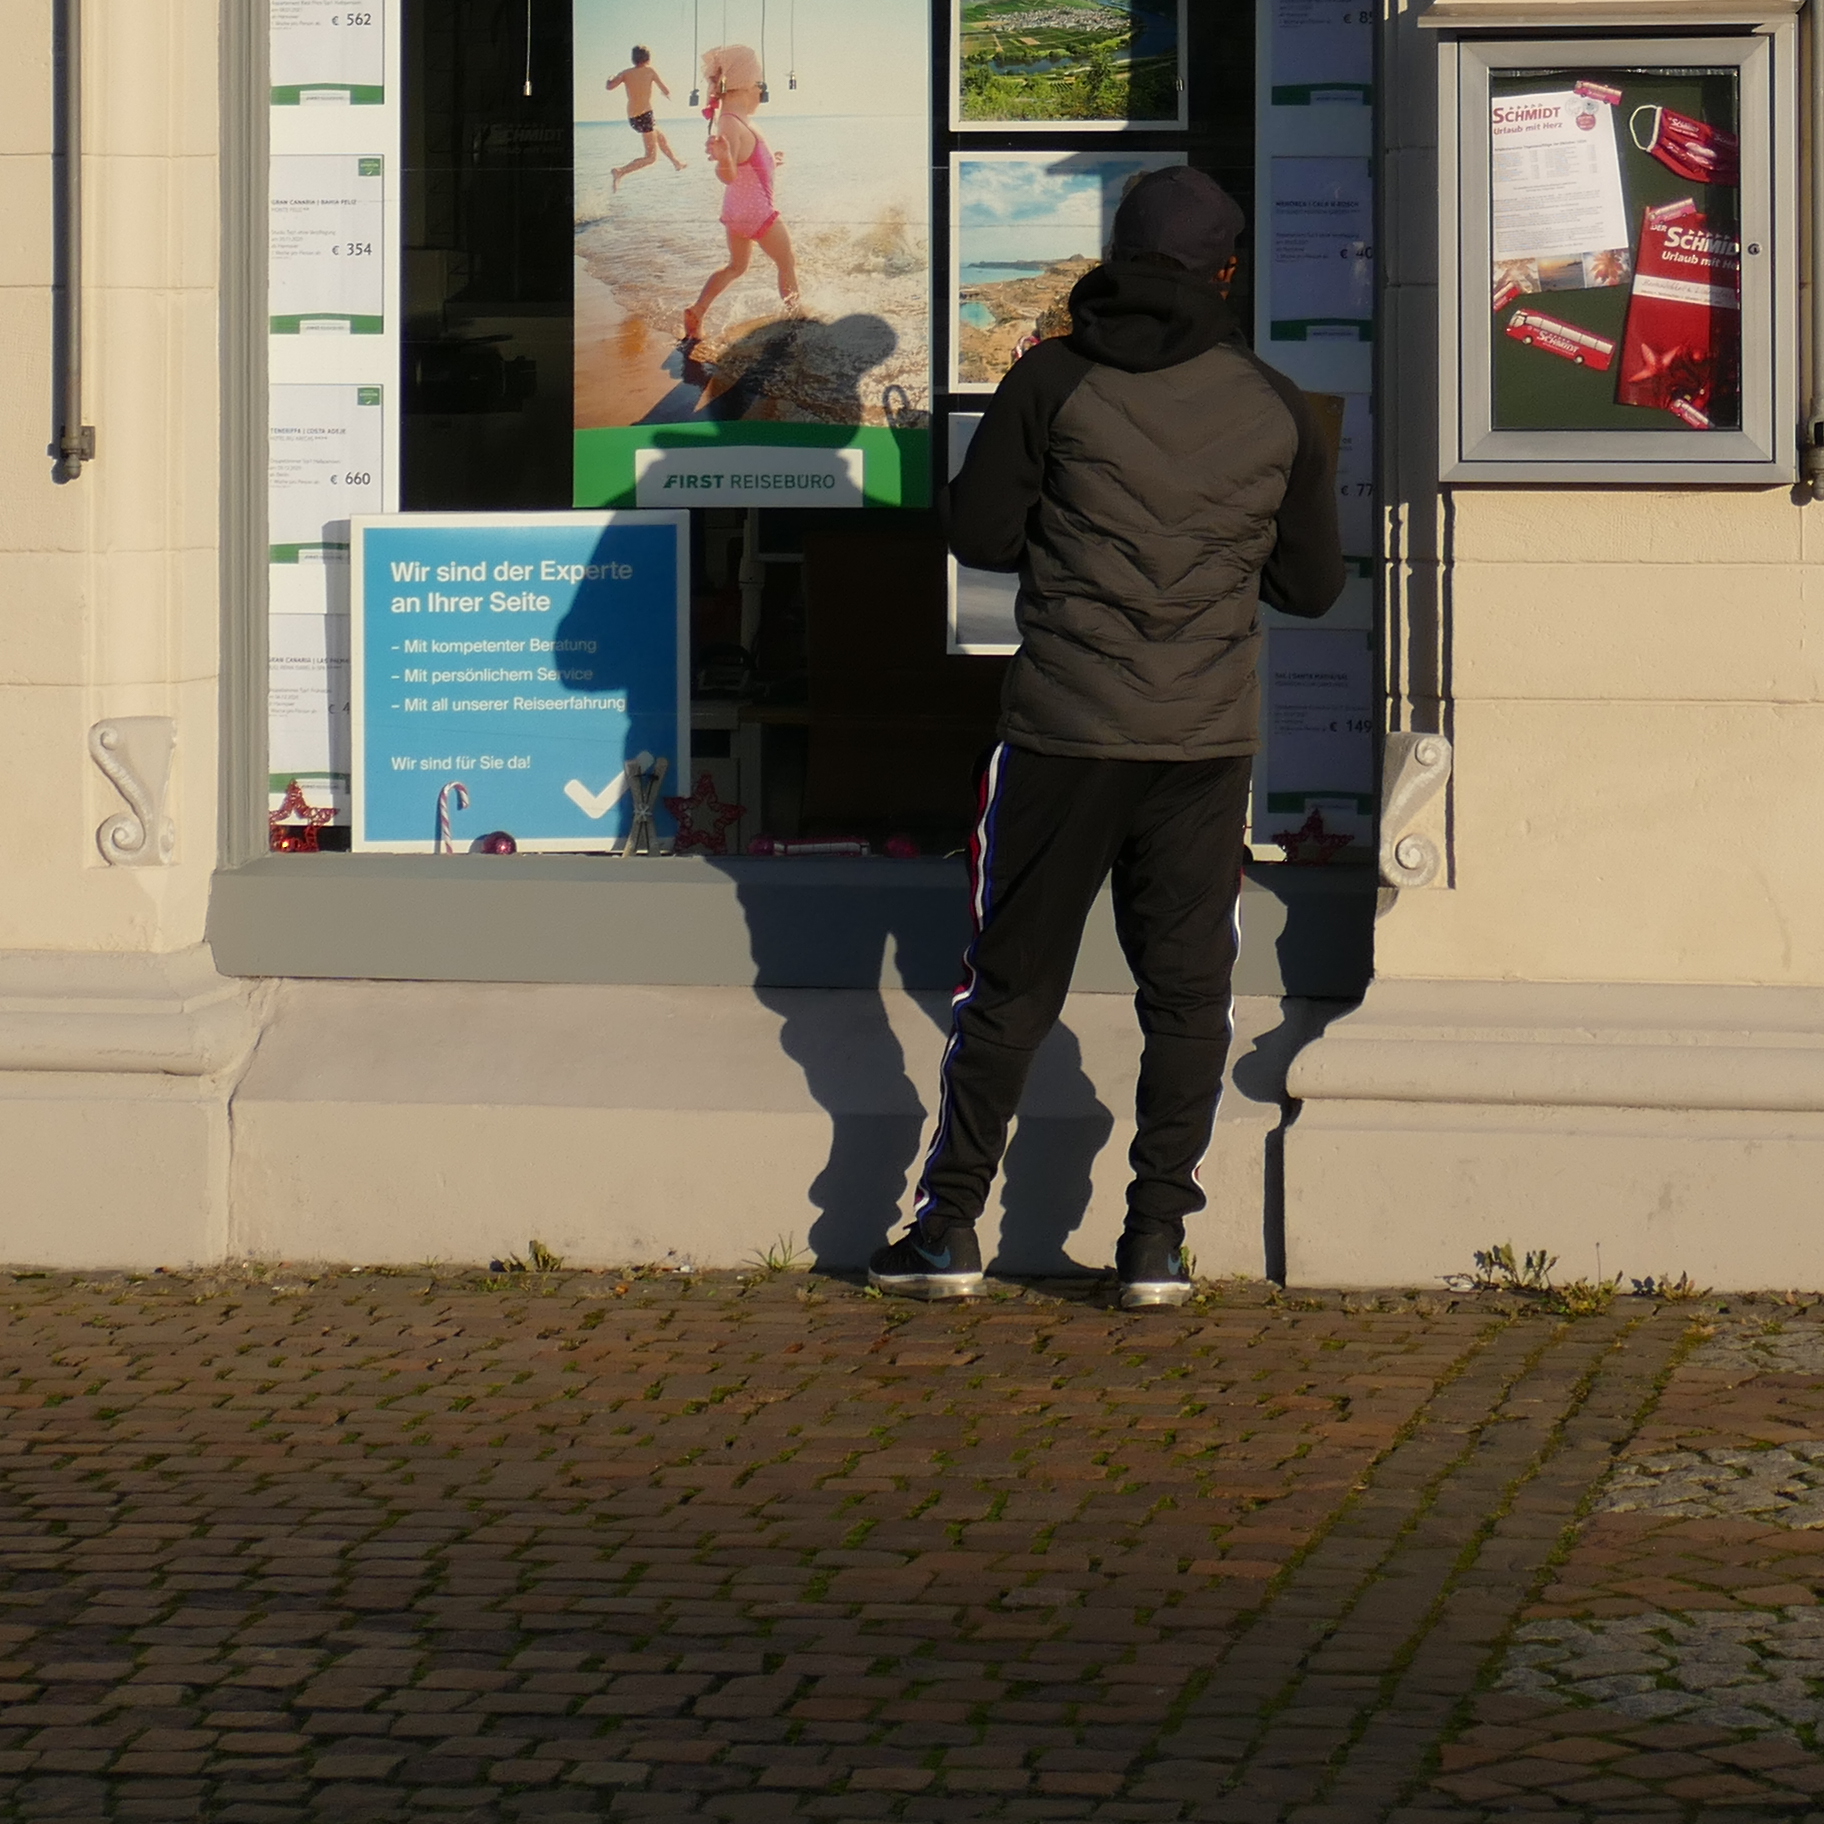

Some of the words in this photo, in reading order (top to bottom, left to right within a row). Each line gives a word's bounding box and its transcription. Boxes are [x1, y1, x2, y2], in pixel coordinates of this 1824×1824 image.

[347, 13, 371, 26] 562
[1493, 107, 1561, 123] SCHMIDT
[1494, 125, 1523, 136] Urlaub
[1526, 124, 1540, 132] mit
[1543, 122, 1562, 130] Herz
[347, 243, 372, 256] 354
[1661, 250, 1698, 264] Urlaub
[1702, 256, 1720, 268] mit
[345, 472, 371, 485] 660
[663, 474, 724, 489] FIRST
[731, 473, 835, 489] REISEBÜRO
[391, 561, 430, 582] Wir
[437, 561, 486, 582] sind
[494, 561, 533, 581] der
[540, 560, 632, 584] Experte
[391, 596, 420, 613] an
[428, 592, 484, 613] Ihrer
[490, 591, 551, 612] Seite
[404, 639, 427, 653] Mit
[432, 639, 525, 655] kompetenter
[530, 638, 596, 654] Beratung
[404, 669, 427, 683] Mit
[432, 668, 533, 685] persönlichem
[537, 667, 593, 681] Service
[404, 698, 427, 712] Mit
[432, 698, 448, 711] all
[452, 699, 509, 711] unserer
[513, 696, 626, 714] Reiseerfahrung
[392, 757, 416, 770] Wir
[420, 756, 451, 770] sind
[456, 756, 476, 769] für
[480, 756, 504, 769] Sie
[508, 755, 531, 769] da!
